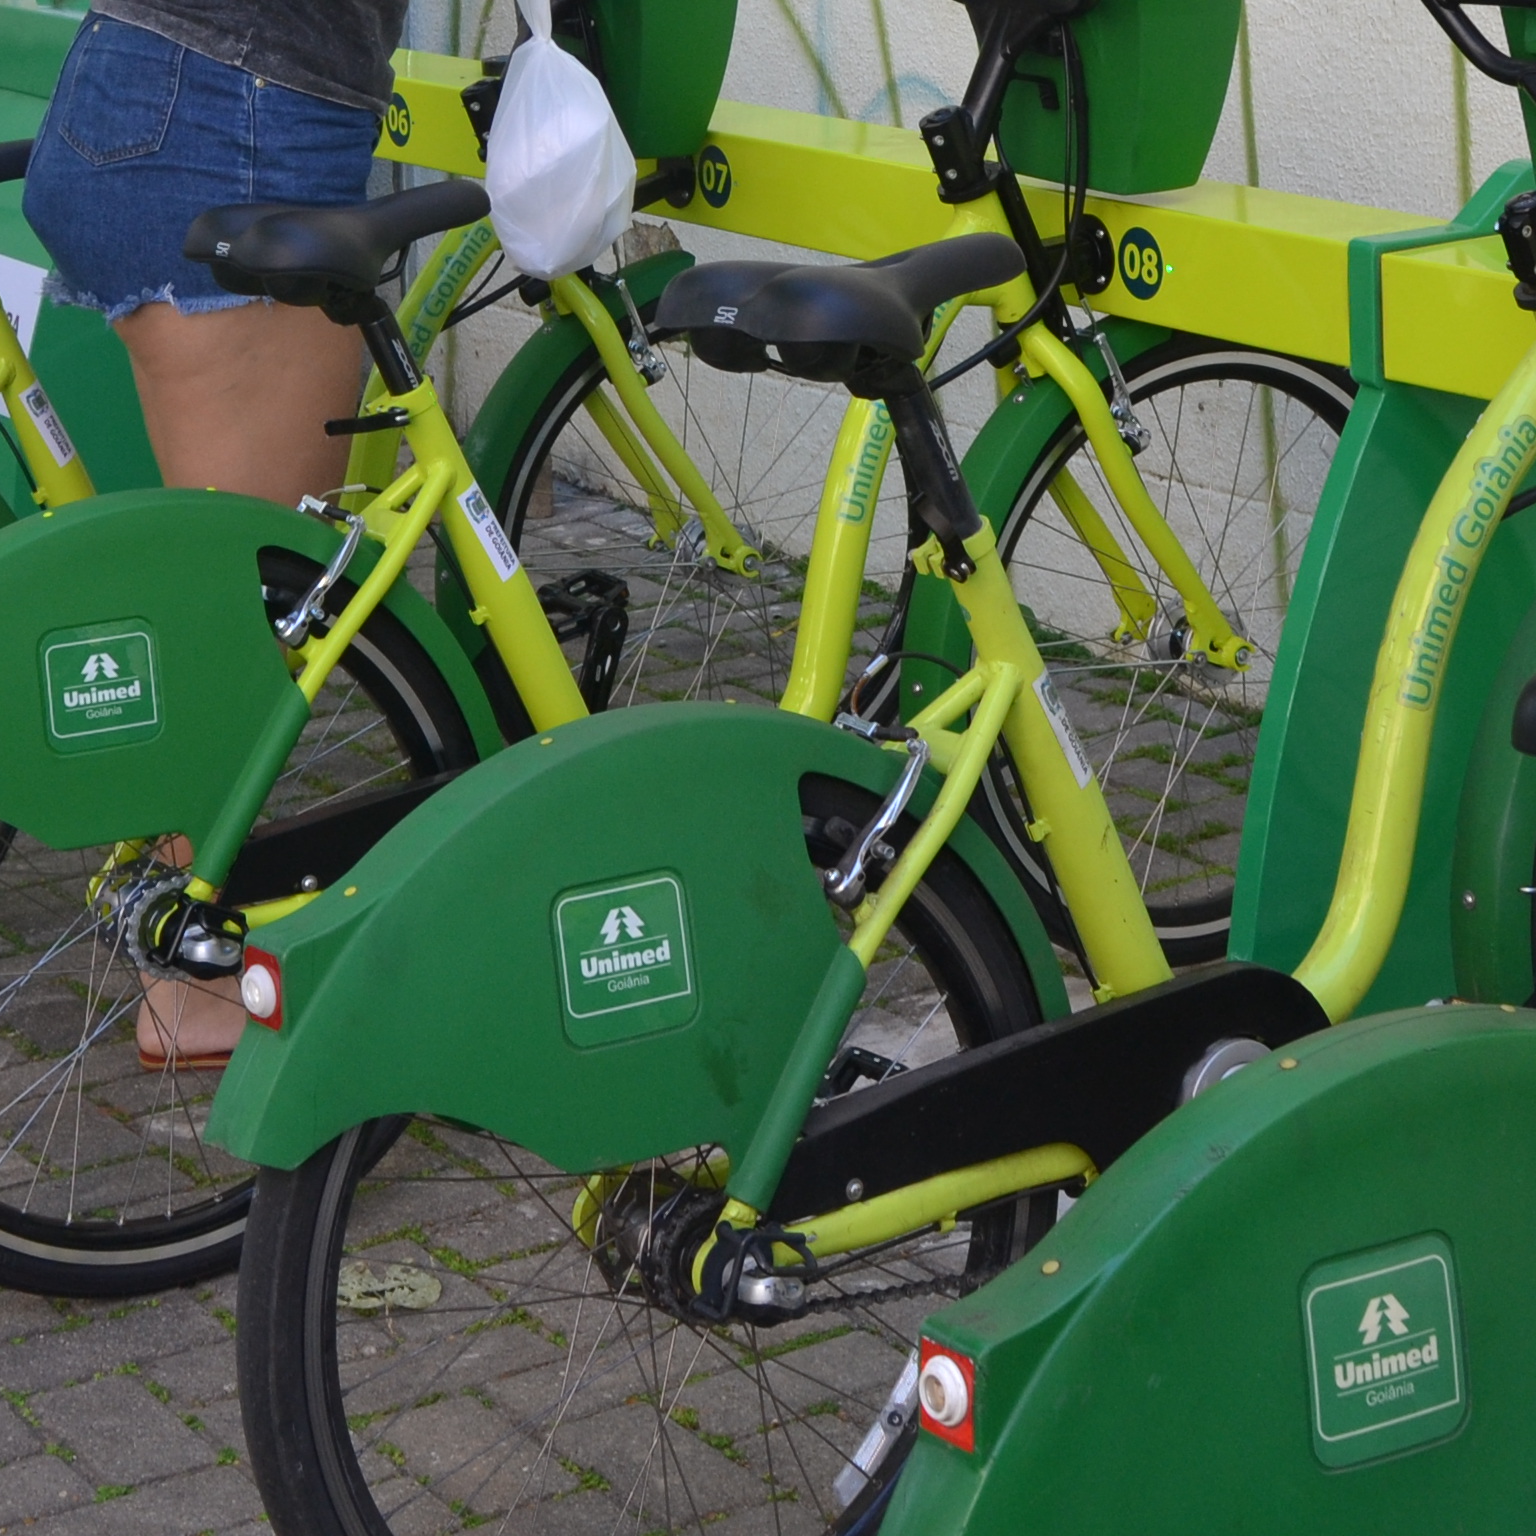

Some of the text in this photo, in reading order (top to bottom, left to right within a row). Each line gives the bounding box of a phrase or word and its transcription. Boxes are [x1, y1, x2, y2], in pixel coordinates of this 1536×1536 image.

[388, 104, 408, 136] 06
[703, 160, 728, 194] 07
[424, 224, 492, 317] Goiânia
[1124, 243, 1159, 285] 08
[841, 401, 893, 522] Unimed
[1403, 555, 1468, 706] Unimed
[64, 680, 141, 707] Unimed
[86, 705, 122, 719] Goiânia
[580, 939, 671, 978] Unimed
[607, 973, 650, 992] Goiânia
[1334, 1335, 1438, 1389] Unimed
[1366, 1380, 1415, 1407] Goiânia
